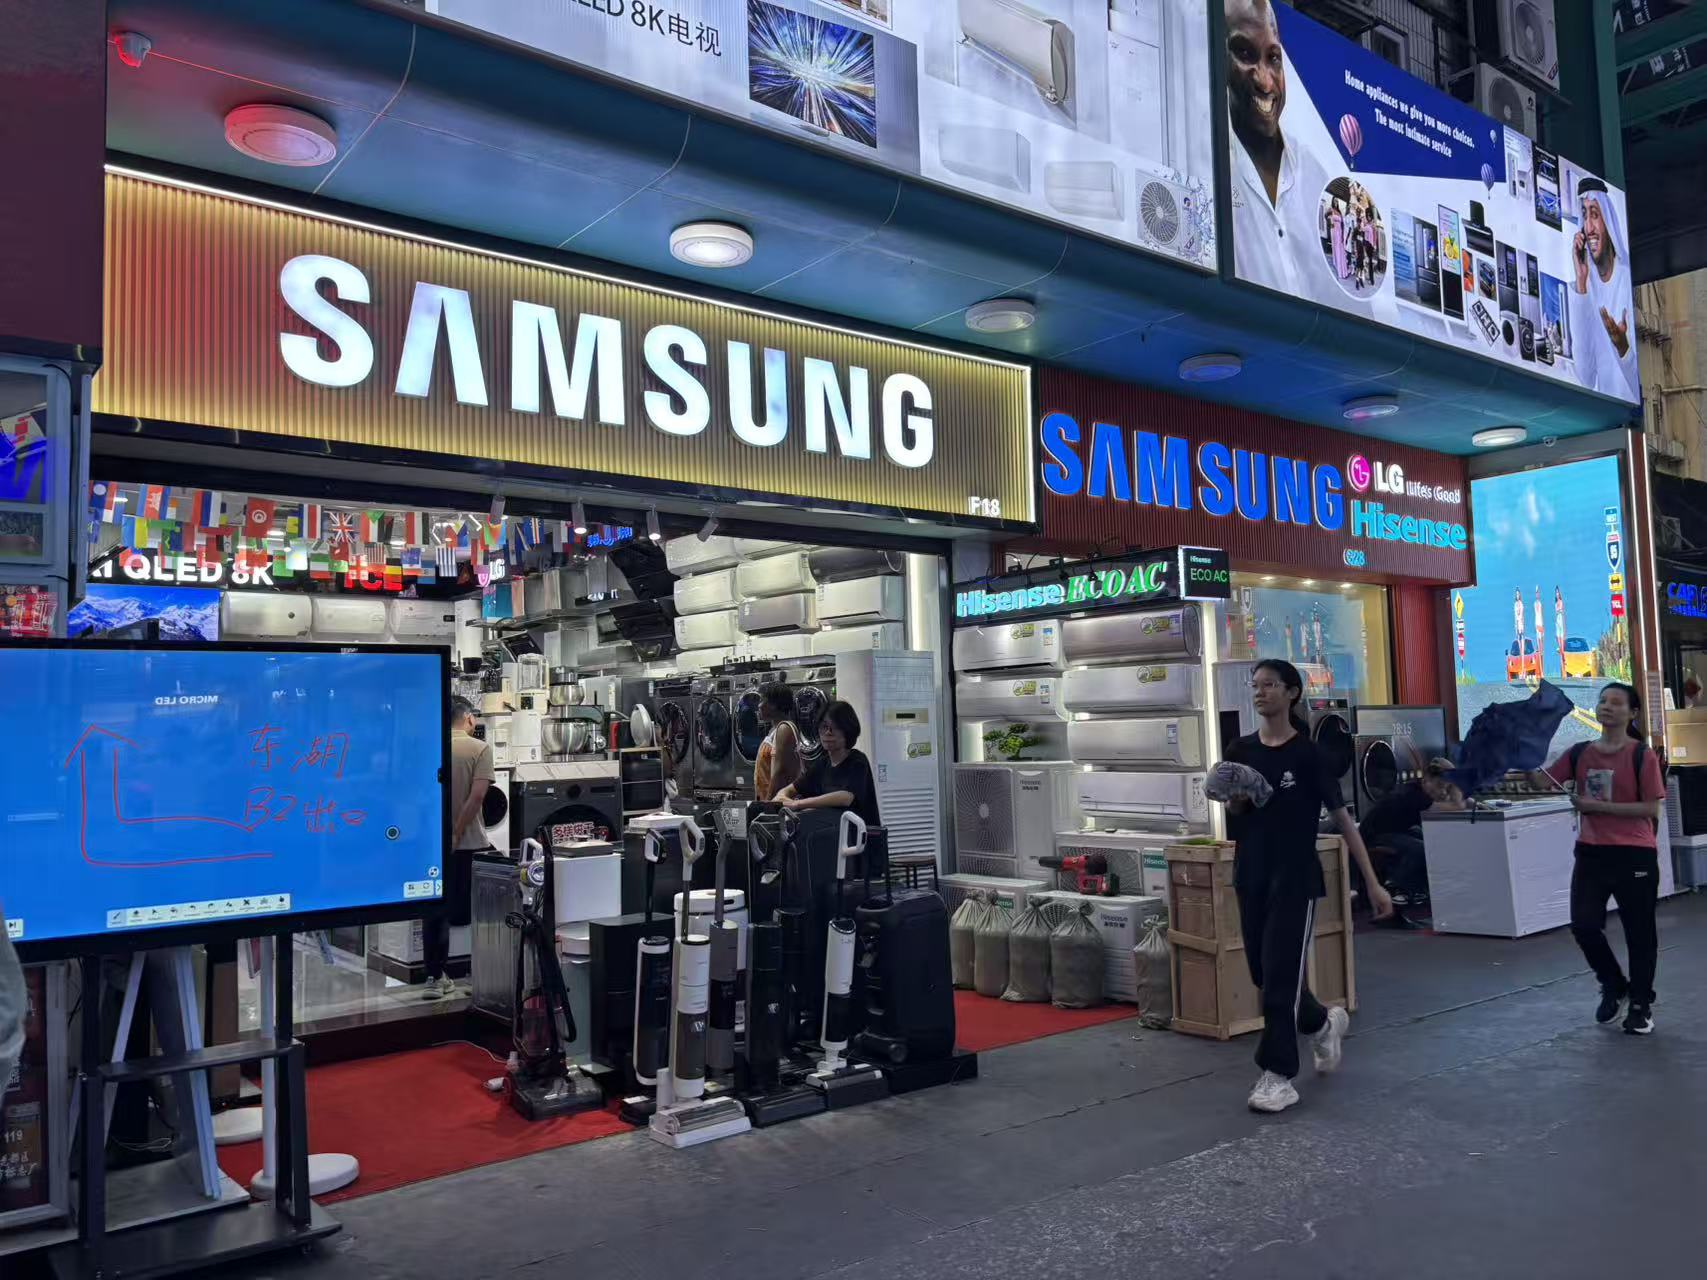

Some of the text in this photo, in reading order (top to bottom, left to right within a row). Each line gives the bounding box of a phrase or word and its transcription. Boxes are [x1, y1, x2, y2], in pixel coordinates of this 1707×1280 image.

[1344, 69, 1364, 92] Home
[1366, 84, 1398, 109] appliances
[1399, 101, 1409, 114] we
[1410, 105, 1423, 121] give
[1424, 114, 1435, 128] you
[1437, 120, 1451, 136] more
[1375, 108, 1387, 126] The
[1388, 118, 1404, 135] most
[1431, 139, 1452, 157] service
[280, 254, 934, 469] SAMSUNG
[1041, 411, 1344, 531] SAMSUNG
[1373, 461, 1405, 495] LG
[1351, 499, 1467, 550] Hisense
[956, 583, 1064, 617] Hisense
[1124, 561, 1168, 595] AC
[1190, 567, 1228, 582] ECO AC
